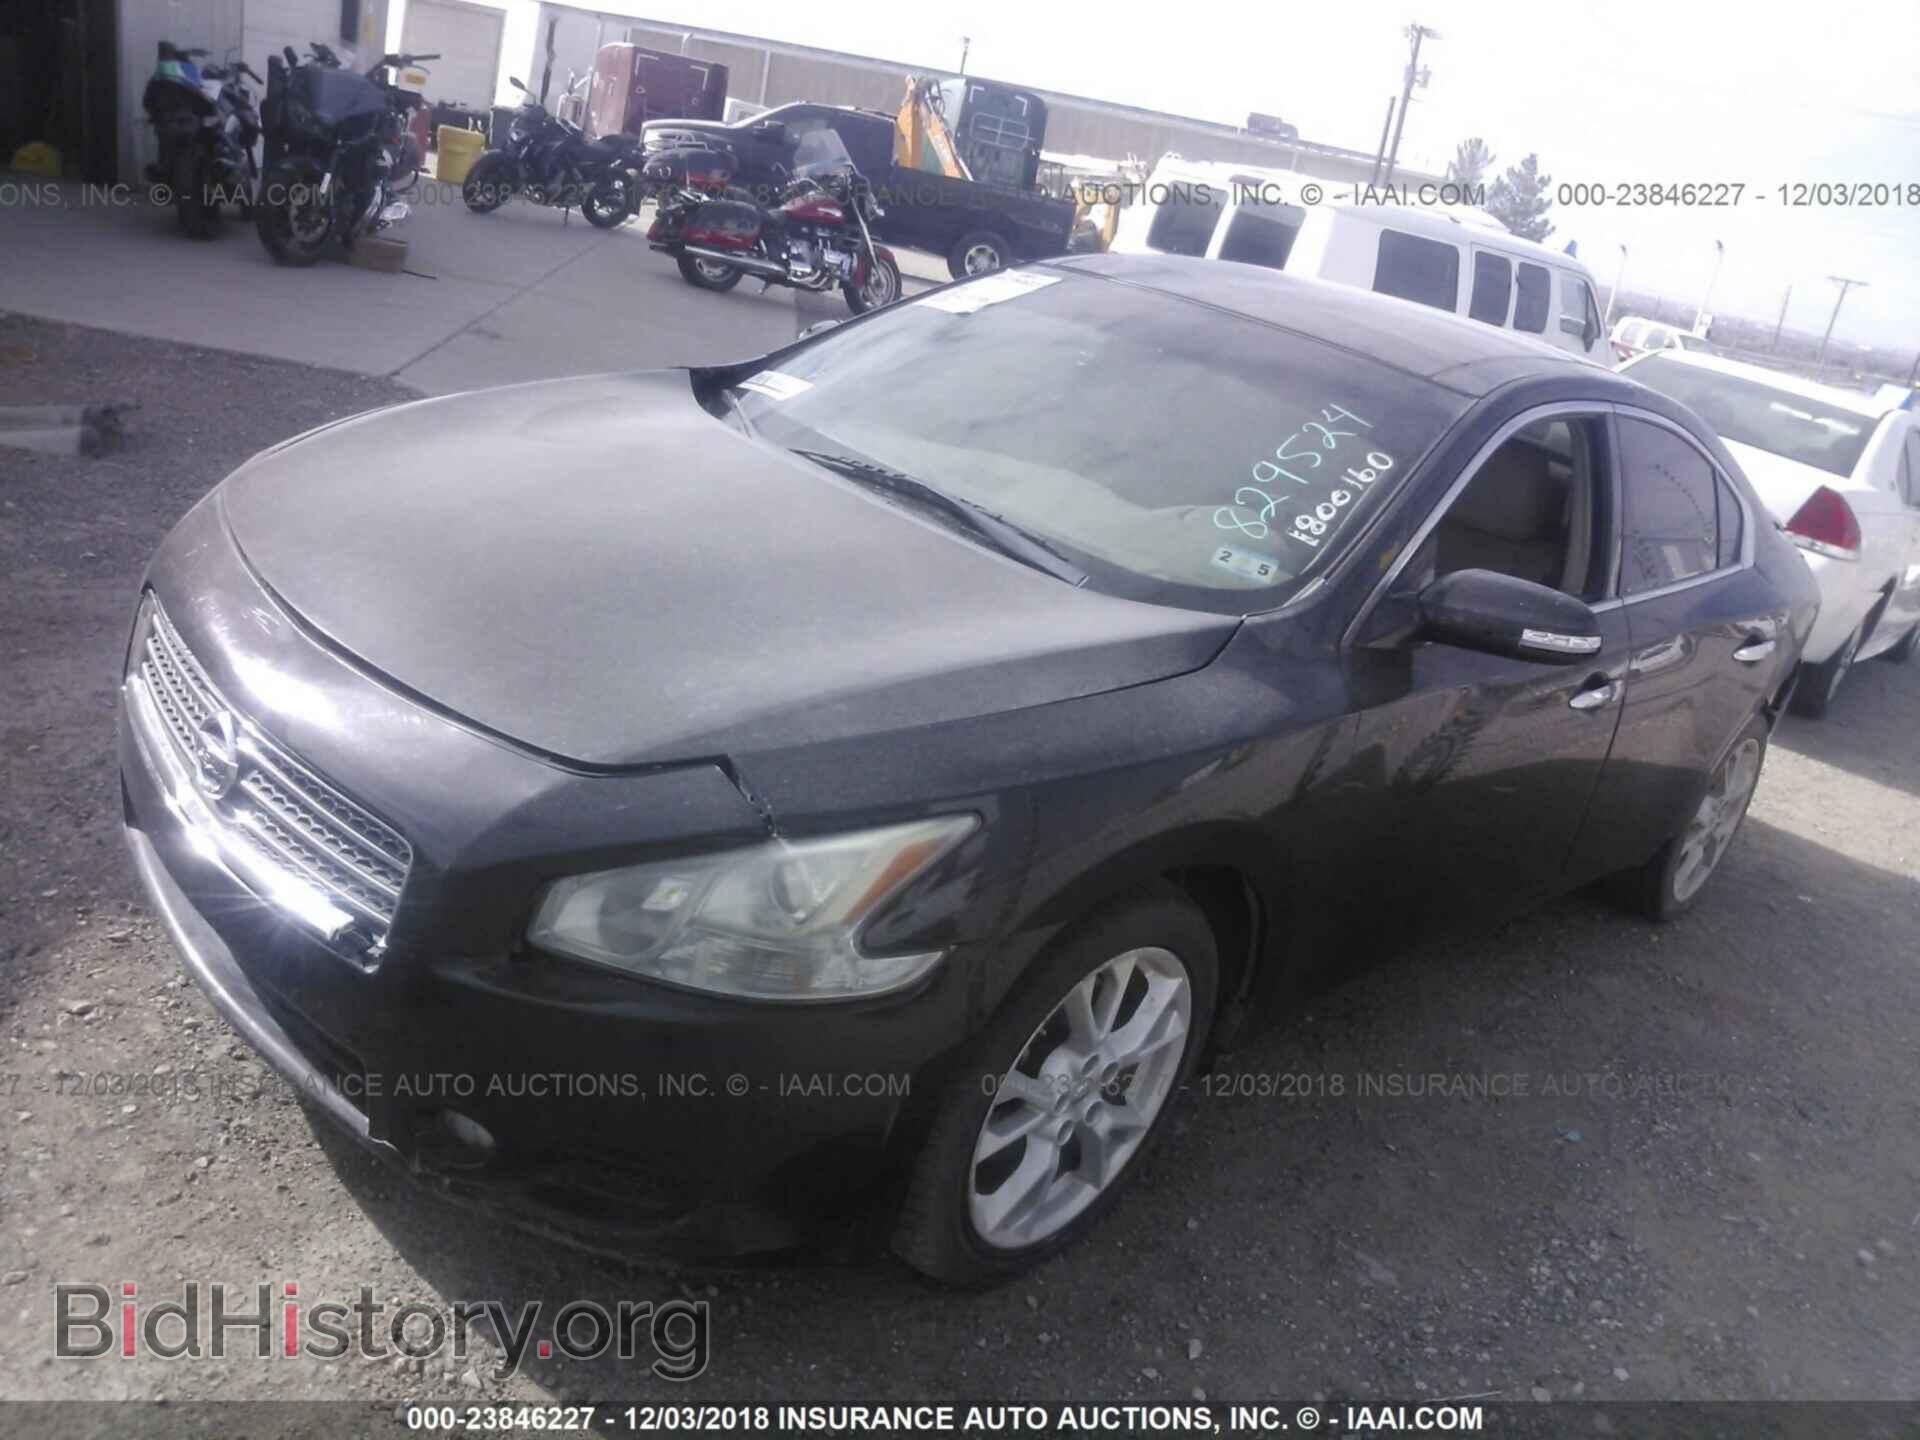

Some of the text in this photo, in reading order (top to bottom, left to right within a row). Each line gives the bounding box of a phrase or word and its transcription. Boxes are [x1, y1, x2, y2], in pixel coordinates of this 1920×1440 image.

[1214, 403, 1374, 539] 829524
[1218, 551, 1270, 577] 2 5
